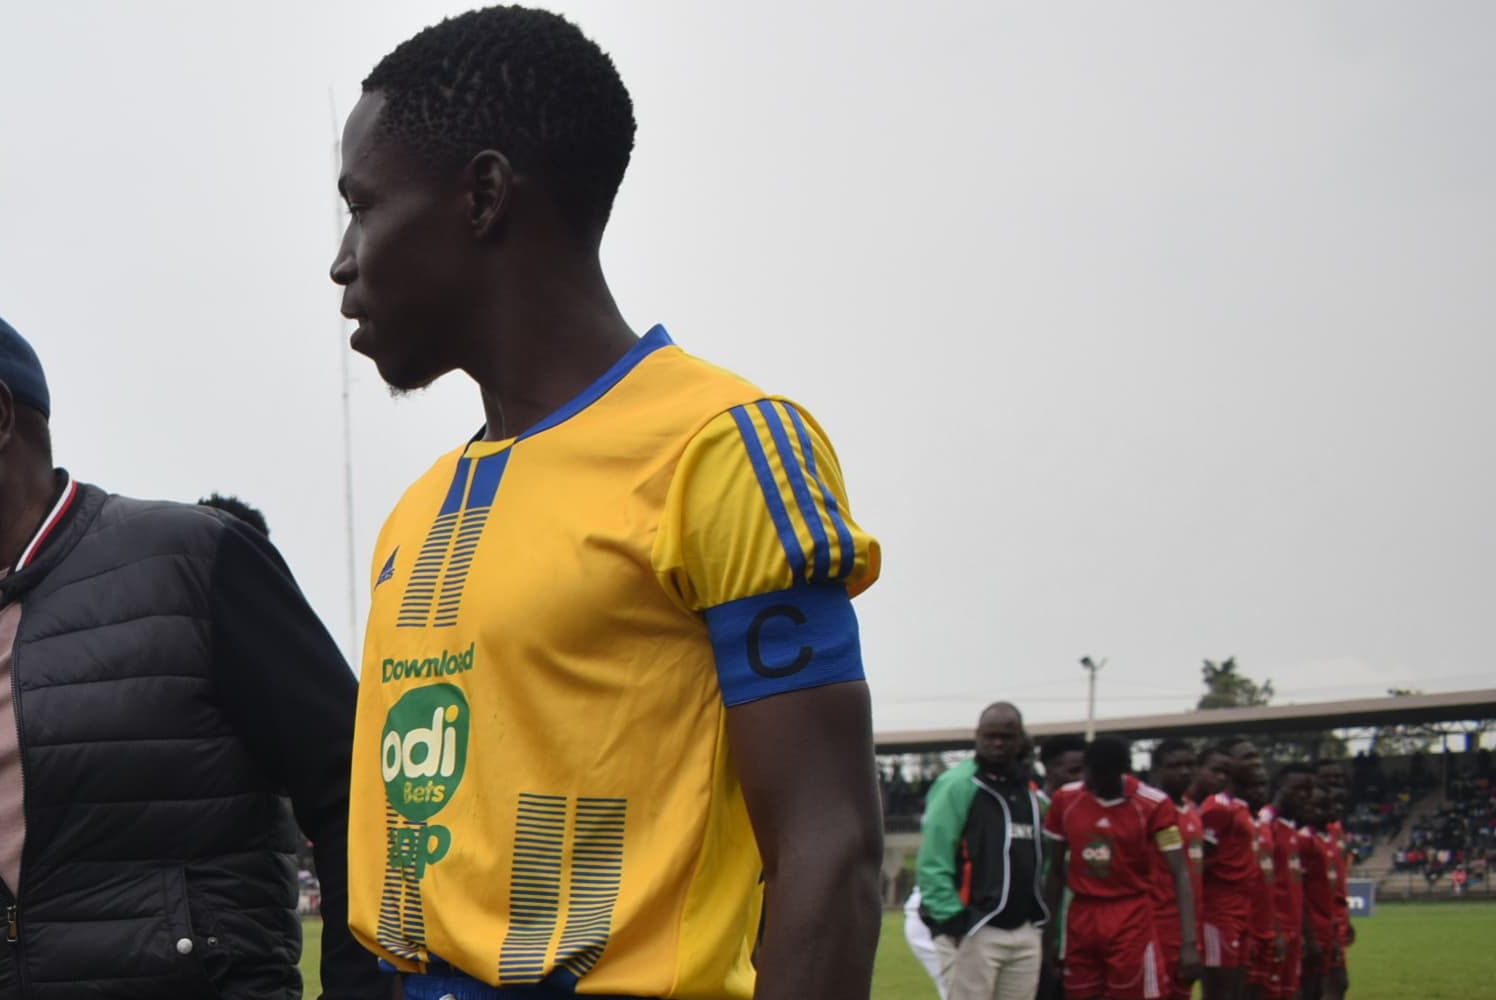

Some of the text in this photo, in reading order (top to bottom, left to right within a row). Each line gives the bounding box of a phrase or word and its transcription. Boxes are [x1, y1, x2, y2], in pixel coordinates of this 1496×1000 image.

[746, 604, 814, 679] C
[382, 704, 459, 783] odi
[403, 780, 447, 804] Bets
